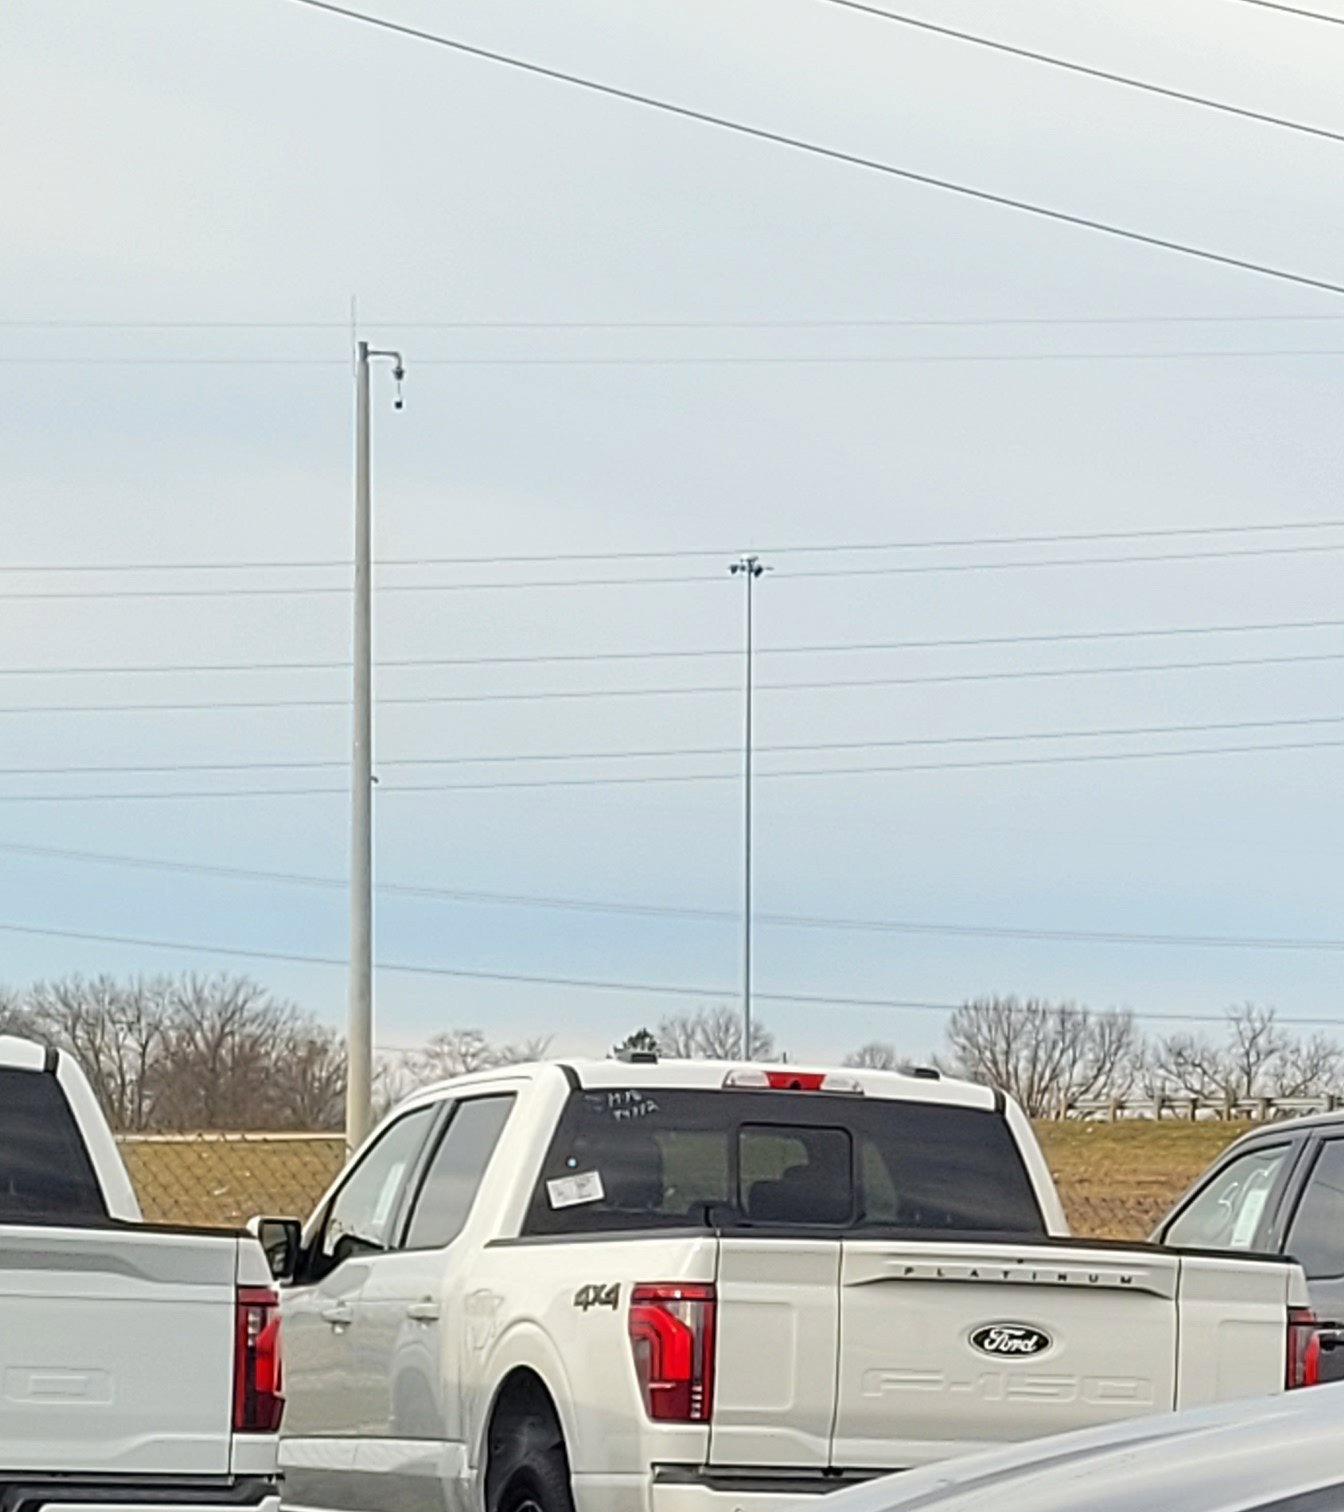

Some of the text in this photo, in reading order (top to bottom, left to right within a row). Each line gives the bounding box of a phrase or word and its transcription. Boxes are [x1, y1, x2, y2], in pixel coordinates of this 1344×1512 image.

[904, 1266, 1133, 1285] PLATINUM
[983, 1327, 1038, 1354] Ford
[861, 1369, 1154, 1404] F-150
